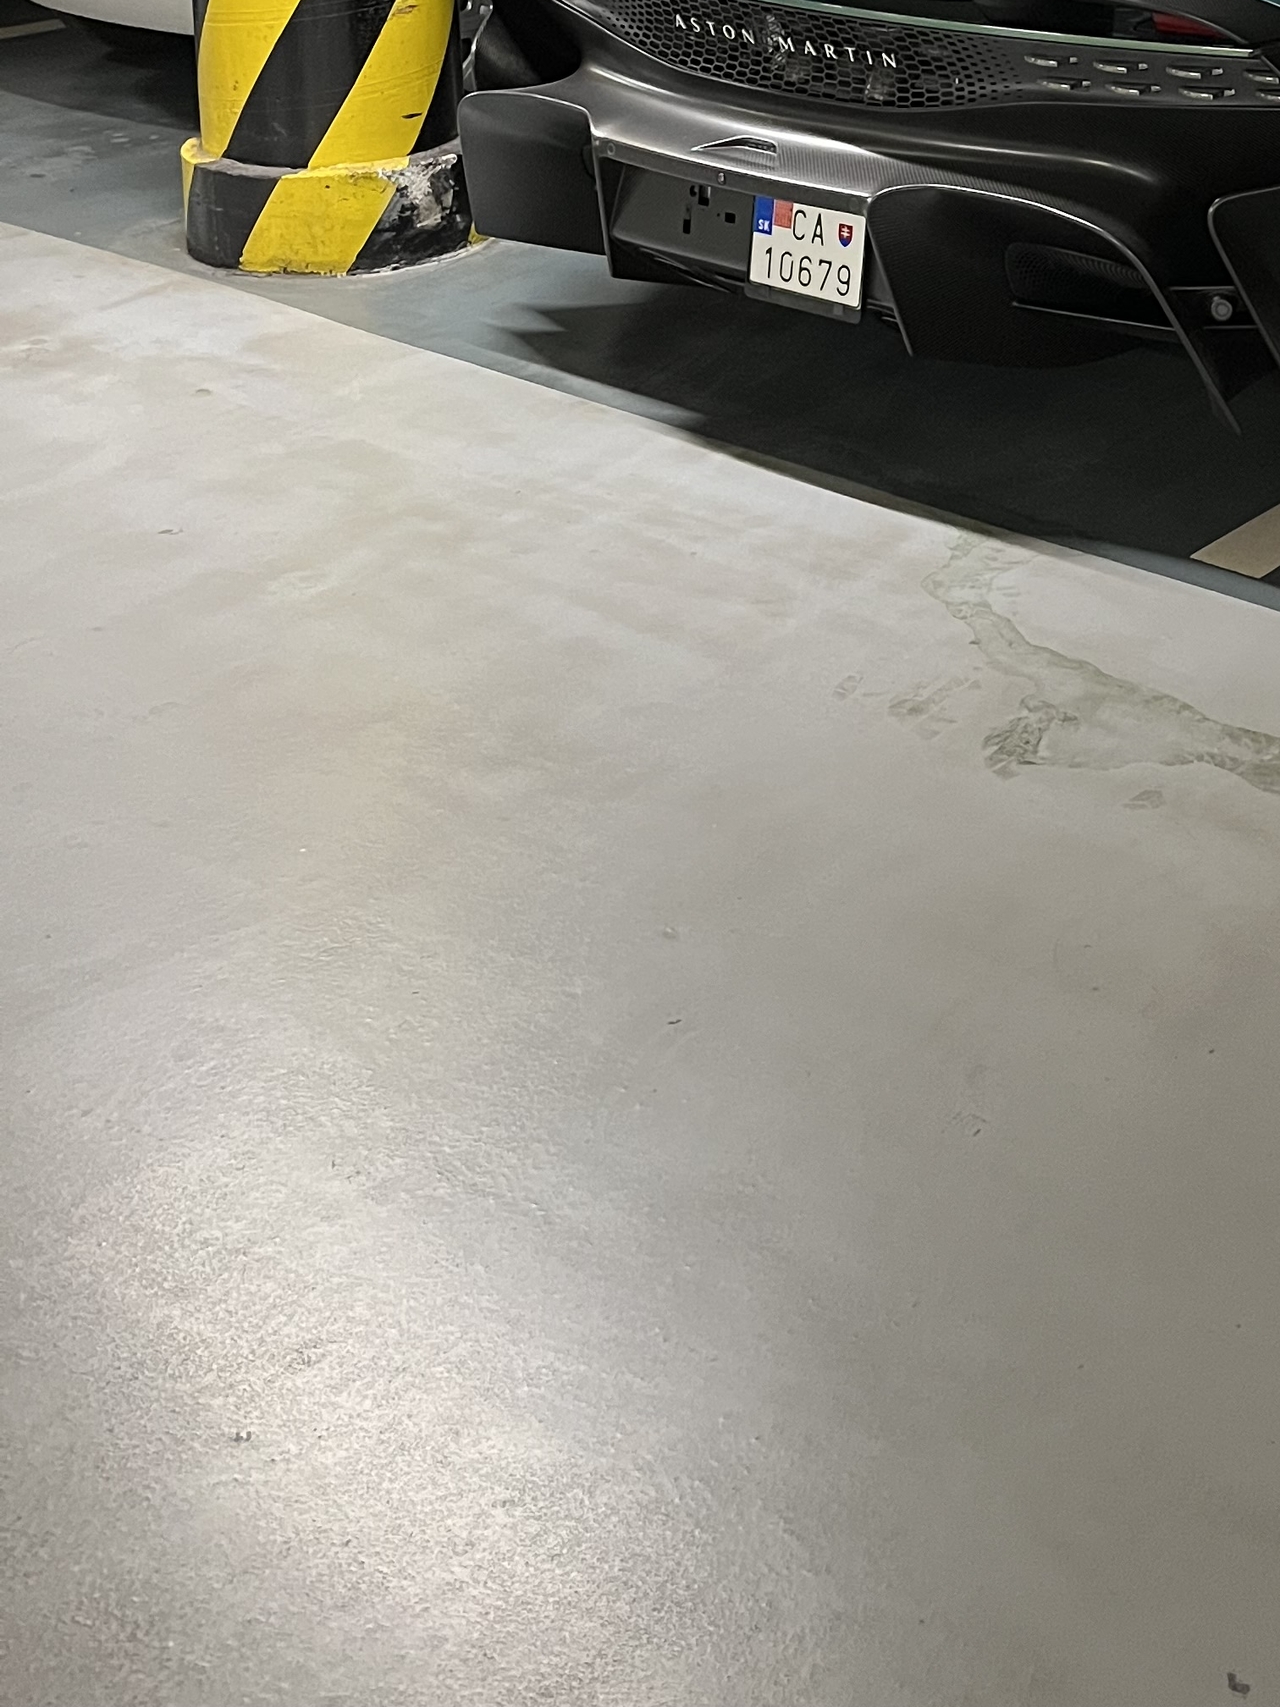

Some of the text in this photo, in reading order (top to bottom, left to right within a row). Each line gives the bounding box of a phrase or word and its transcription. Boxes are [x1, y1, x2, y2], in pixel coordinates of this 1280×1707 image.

[675, 13, 897, 69] ASTON MARTIN
[758, 219, 770, 232] SK
[792, 209, 824, 247] CA
[765, 246, 852, 297] 10679
